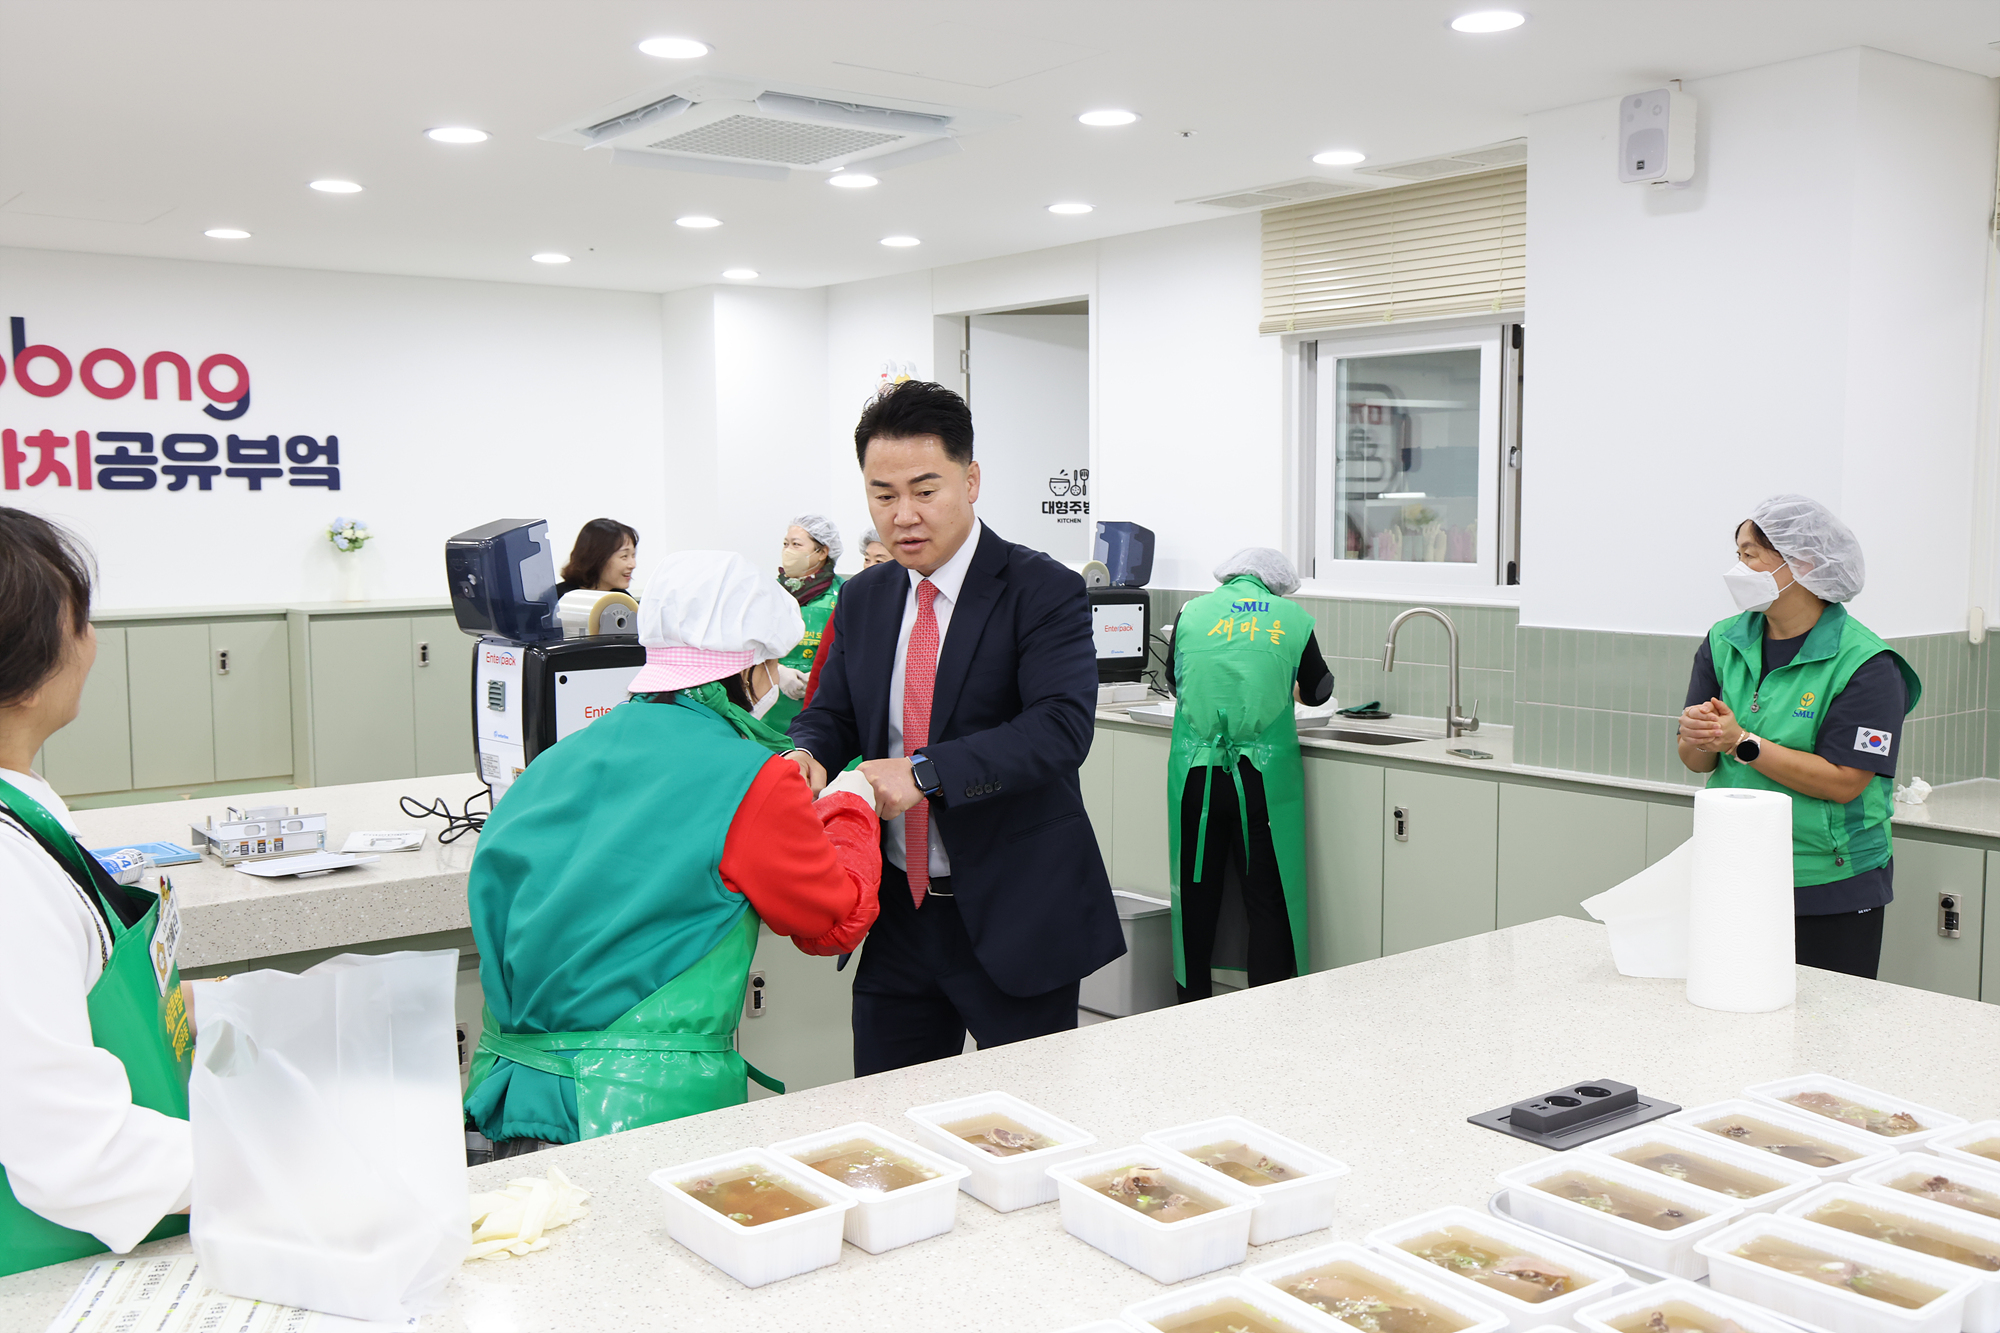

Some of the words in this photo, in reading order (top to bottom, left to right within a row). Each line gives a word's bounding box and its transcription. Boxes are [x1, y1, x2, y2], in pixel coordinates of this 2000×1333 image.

[0, 316, 250, 421] bong
[1230, 601, 1270, 613] SMU
[1207, 616, 1286, 645] 새마을
[584, 706, 612, 718] Ente
[1792, 709, 1815, 719] SMU
